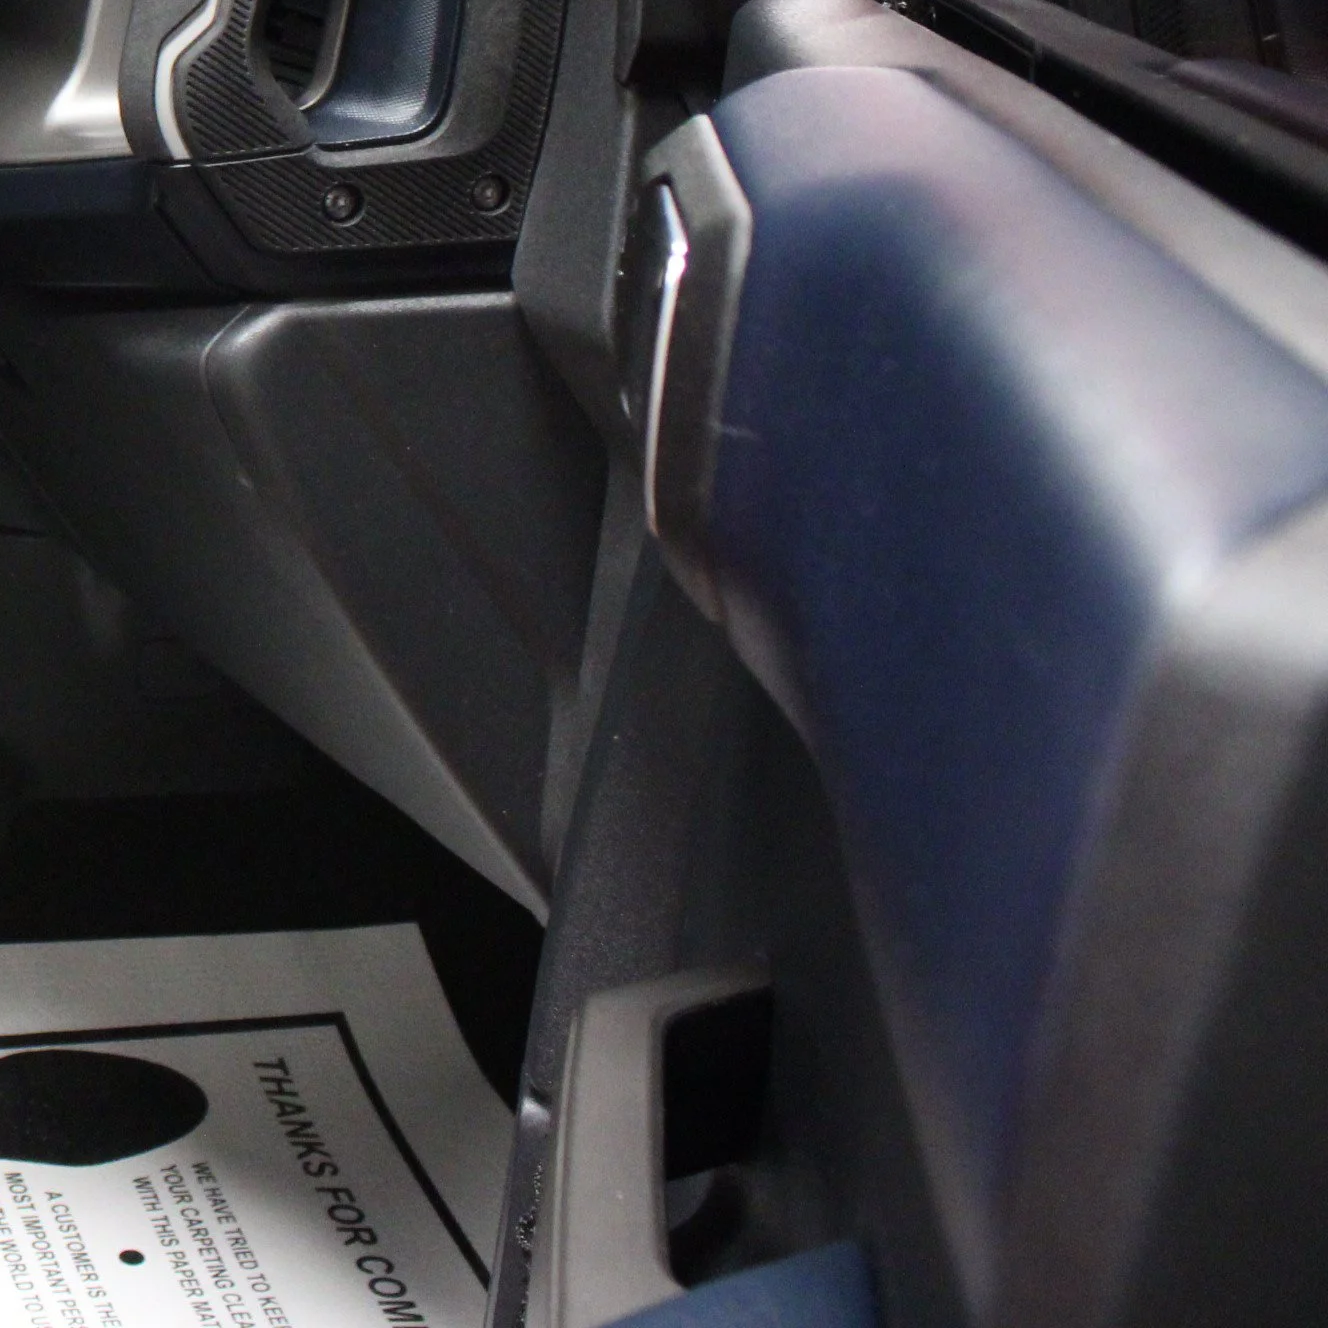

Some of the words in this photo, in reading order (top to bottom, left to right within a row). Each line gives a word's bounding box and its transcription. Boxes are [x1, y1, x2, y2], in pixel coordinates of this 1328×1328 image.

[191, 1160, 217, 1185] WE
[44, 1190, 63, 1202] A
[203, 1186, 238, 1225] HAVE
[253, 1057, 339, 1178] THANKS
[315, 1186, 378, 1246] FOR
[356, 1255, 430, 1328] COM
[51, 1203, 99, 1283] CUSTOMER
[160, 1163, 193, 1205] YOUR
[180, 1206, 235, 1290] CARPETING
[4, 1171, 36, 1212] MOST
[20, 1215, 72, 1296] IMPORTANT
[57, 1298, 90, 1328] PER
[132, 1175, 164, 1213] WITH
[150, 1215, 180, 1248] THIS
[165, 1250, 205, 1299] PAPER
[191, 1300, 222, 1328] MAT
[224, 1227, 259, 1271] TRIED
[85, 1285, 107, 1300] IS
[247, 1273, 271, 1293] TO
[21, 1294, 45, 1313] TO
[95, 1301, 123, 1328] THE
[31, 1315, 54, 1328] U
